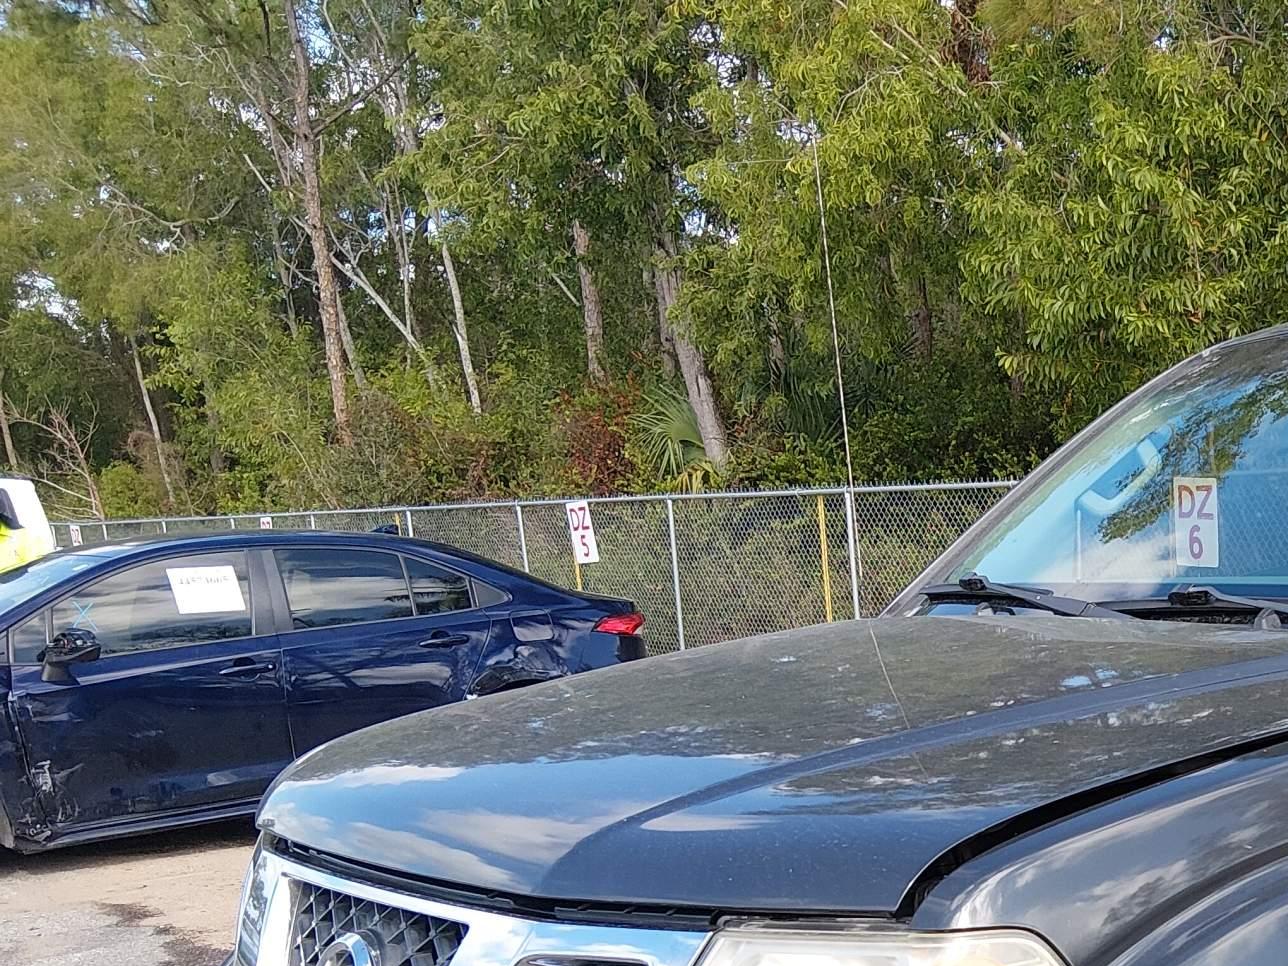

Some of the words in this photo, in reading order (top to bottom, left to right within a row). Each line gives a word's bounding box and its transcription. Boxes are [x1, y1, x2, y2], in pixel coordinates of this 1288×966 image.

[1177, 484, 1214, 520] DZ
[568, 506, 591, 532] DZ
[580, 534, 590, 558] 5
[1188, 524, 1203, 560] 6
